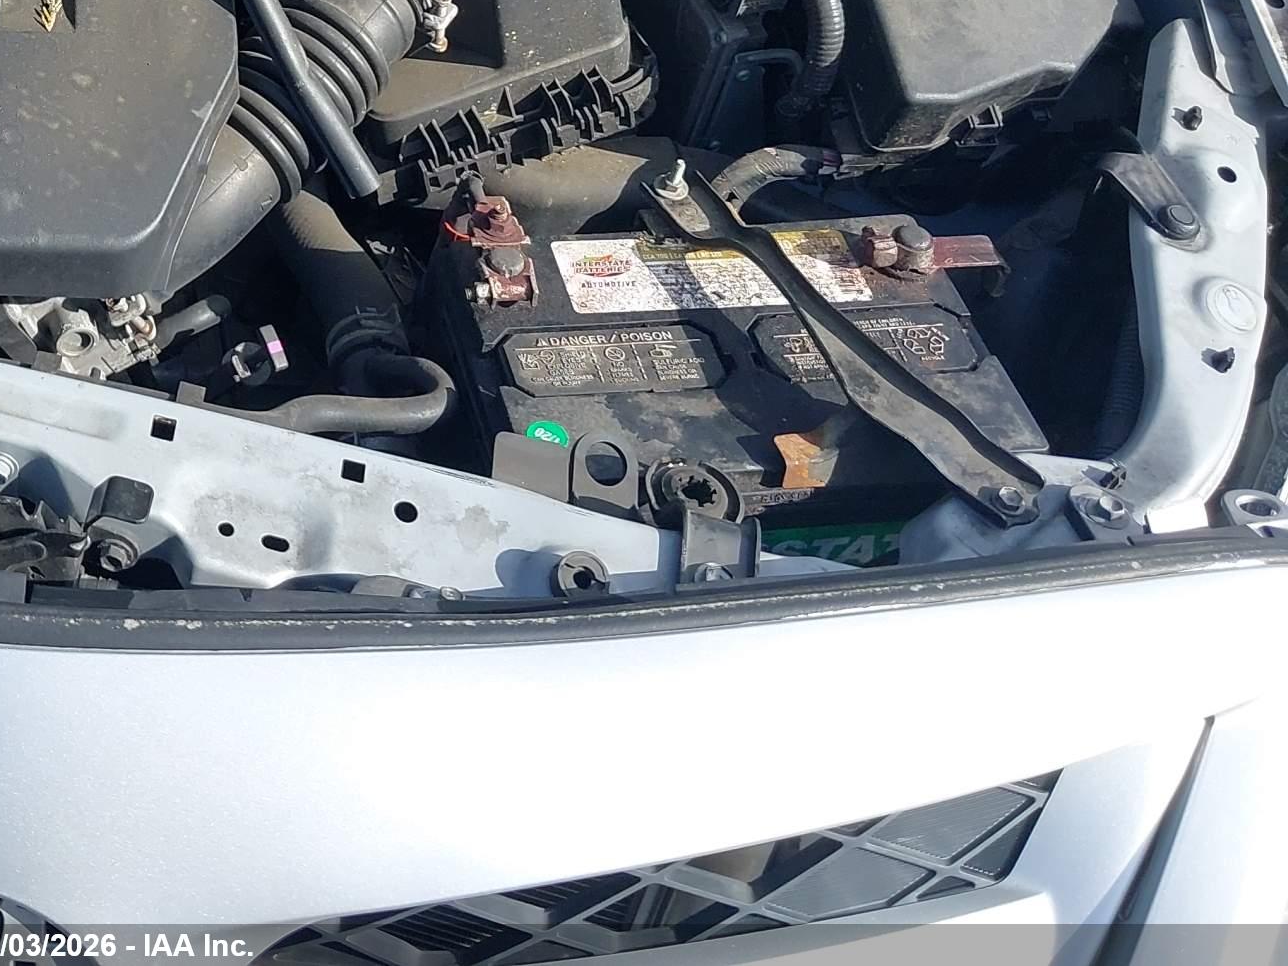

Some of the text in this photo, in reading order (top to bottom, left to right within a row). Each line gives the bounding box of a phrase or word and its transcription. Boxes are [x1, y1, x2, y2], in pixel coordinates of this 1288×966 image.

[571, 259, 633, 268] INTERSTATE
[575, 265, 631, 275] BATTERIES
[580, 280, 637, 289] AUTOMOTIVE
[549, 334, 607, 347] DANGER
[620, 331, 673, 343] POISON
